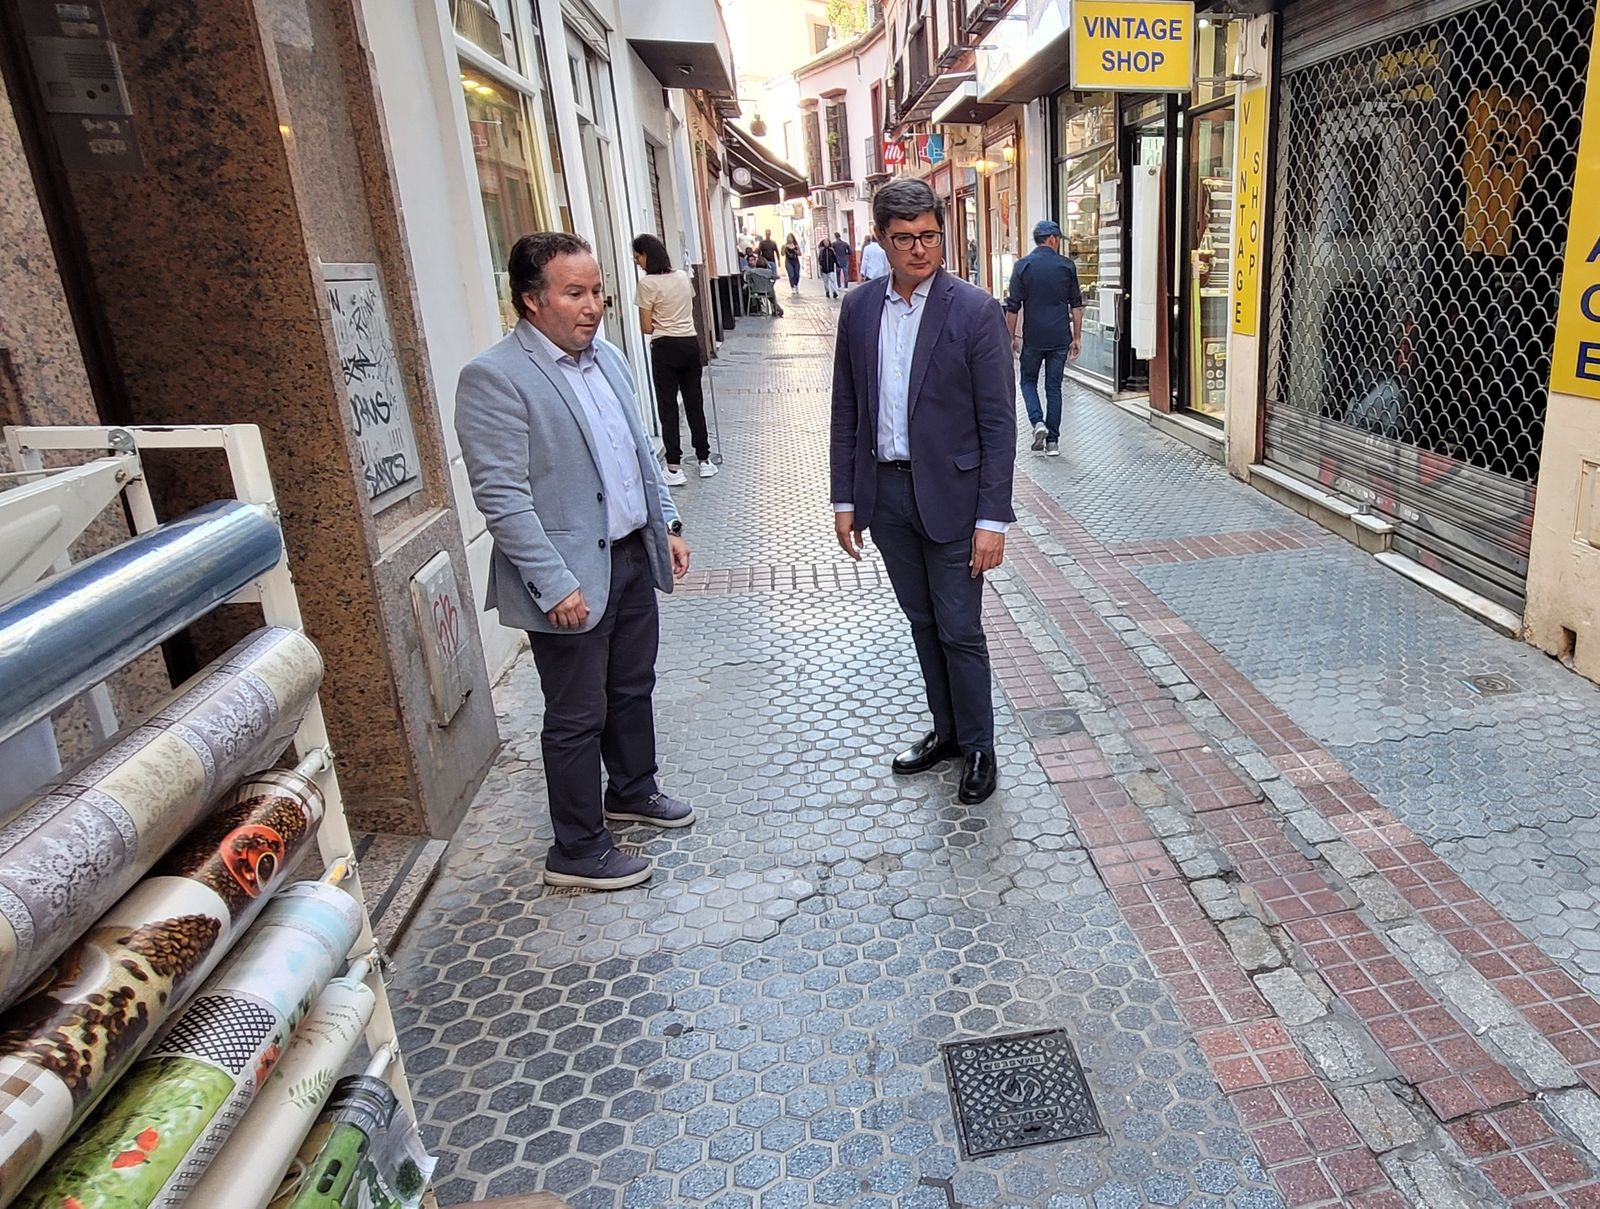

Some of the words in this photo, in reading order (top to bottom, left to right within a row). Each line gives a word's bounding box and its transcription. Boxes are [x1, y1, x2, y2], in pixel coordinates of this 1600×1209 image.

[1083, 15, 1183, 41] VINTAGE
[1101, 49, 1165, 73] SHOP
[884, 144, 905, 163] illy
[1235, 102, 1251, 324] VINTAGE
[1248, 151, 1260, 276] SHOP
